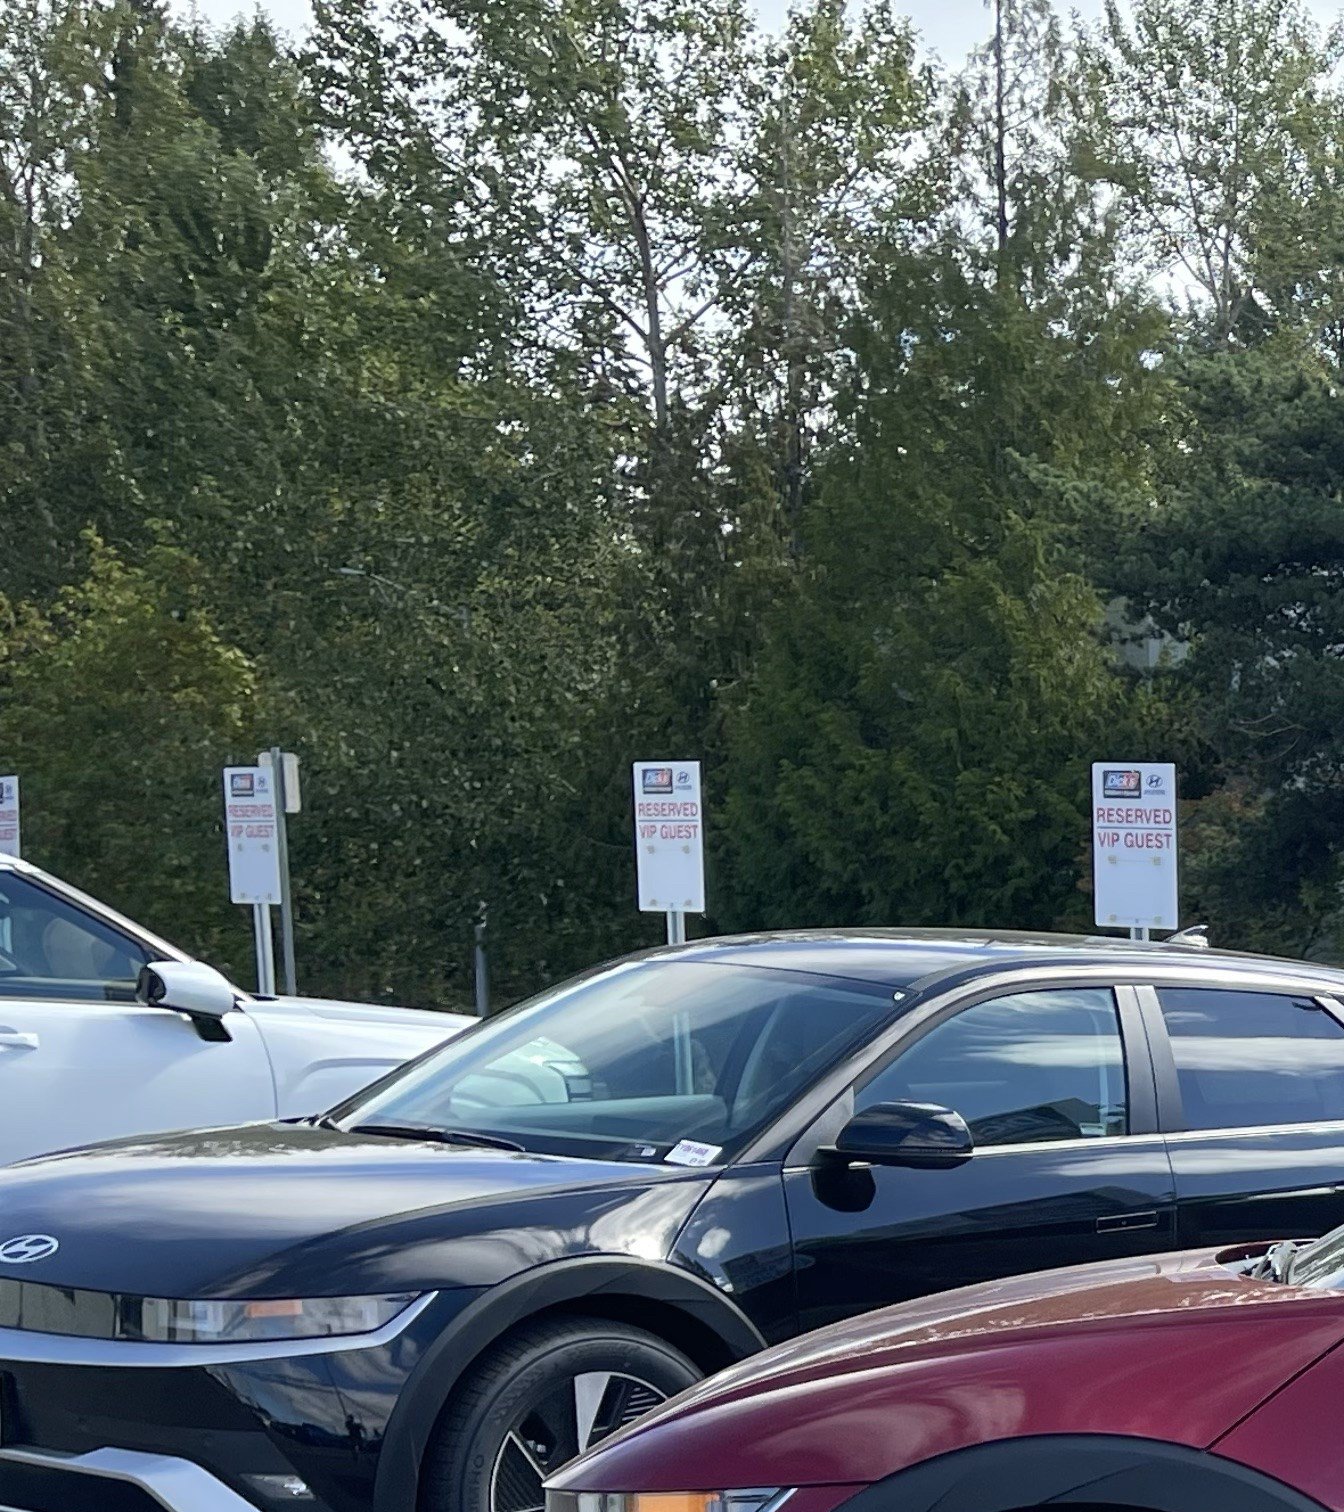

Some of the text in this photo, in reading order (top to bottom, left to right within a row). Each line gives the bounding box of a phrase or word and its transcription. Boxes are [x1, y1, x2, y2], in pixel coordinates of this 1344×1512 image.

[638, 802, 698, 817] RESERVED
[1096, 807, 1173, 824] RESERVED
[639, 825, 698, 839] VIP GUEST
[1097, 832, 1173, 849] VIP GUEST
